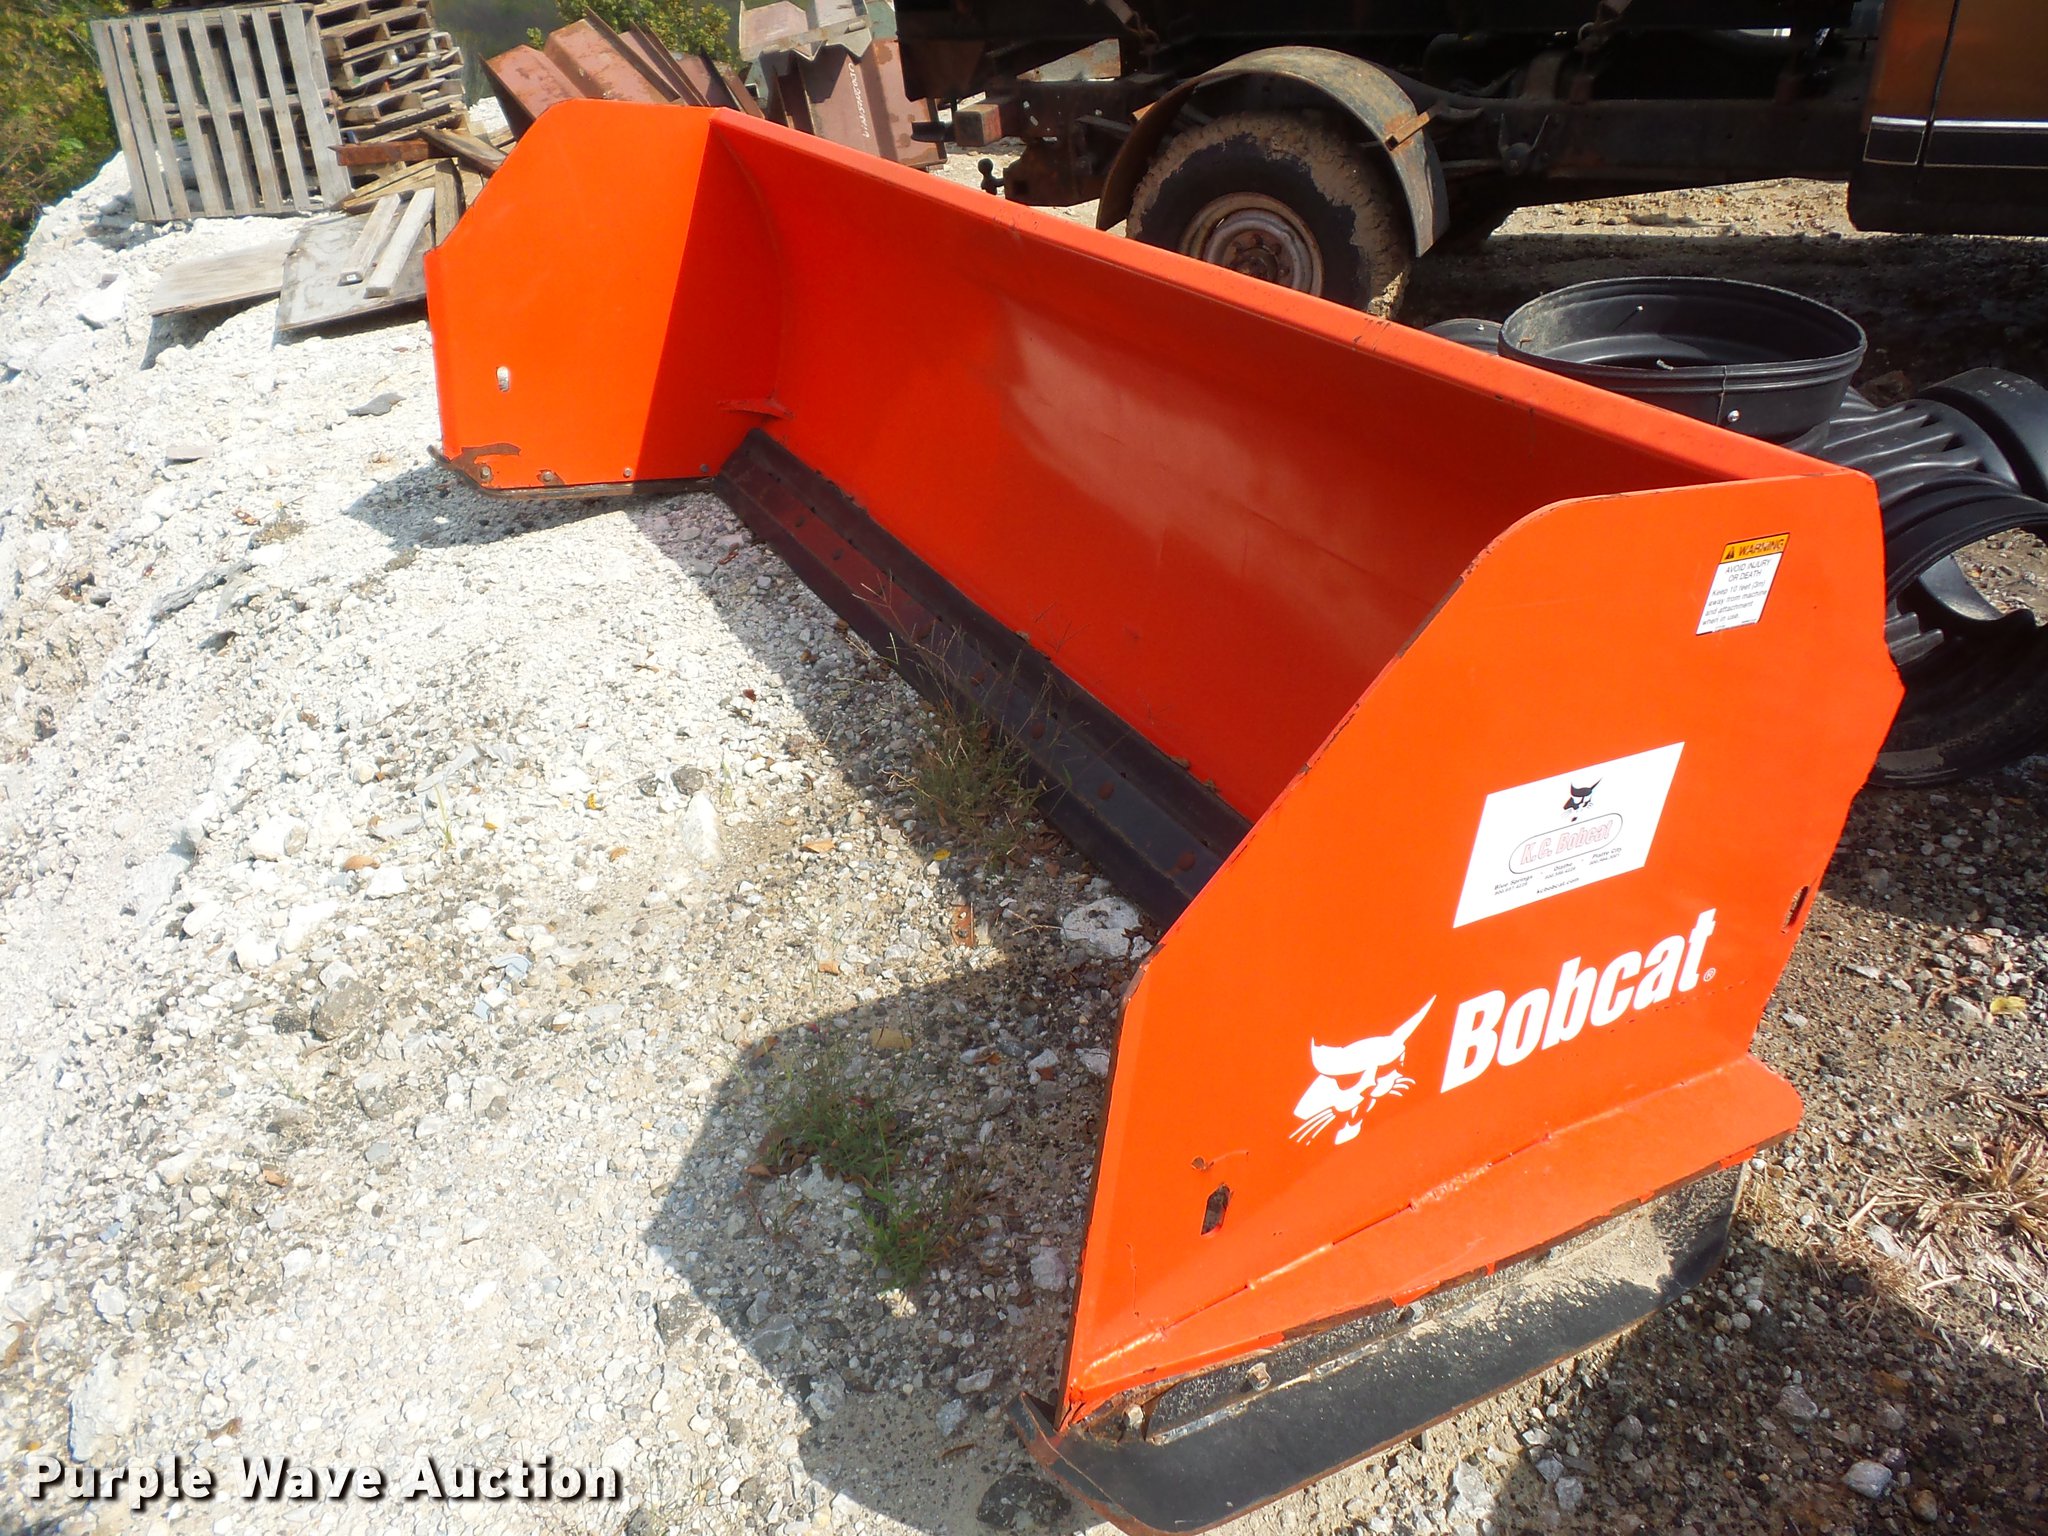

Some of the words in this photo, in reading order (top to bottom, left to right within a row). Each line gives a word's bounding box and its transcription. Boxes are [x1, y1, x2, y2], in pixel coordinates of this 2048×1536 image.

[1738, 538, 1785, 557] WARNING
[1726, 563, 1746, 573] AVOID
[1747, 559, 1770, 569] INJURY
[1728, 573, 1740, 583] OR
[1740, 570, 1761, 580] DEATH
[1520, 837, 1553, 866] K.C.
[1555, 818, 1614, 855] Bobcat
[1440, 907, 1717, 1094] Bobcat
